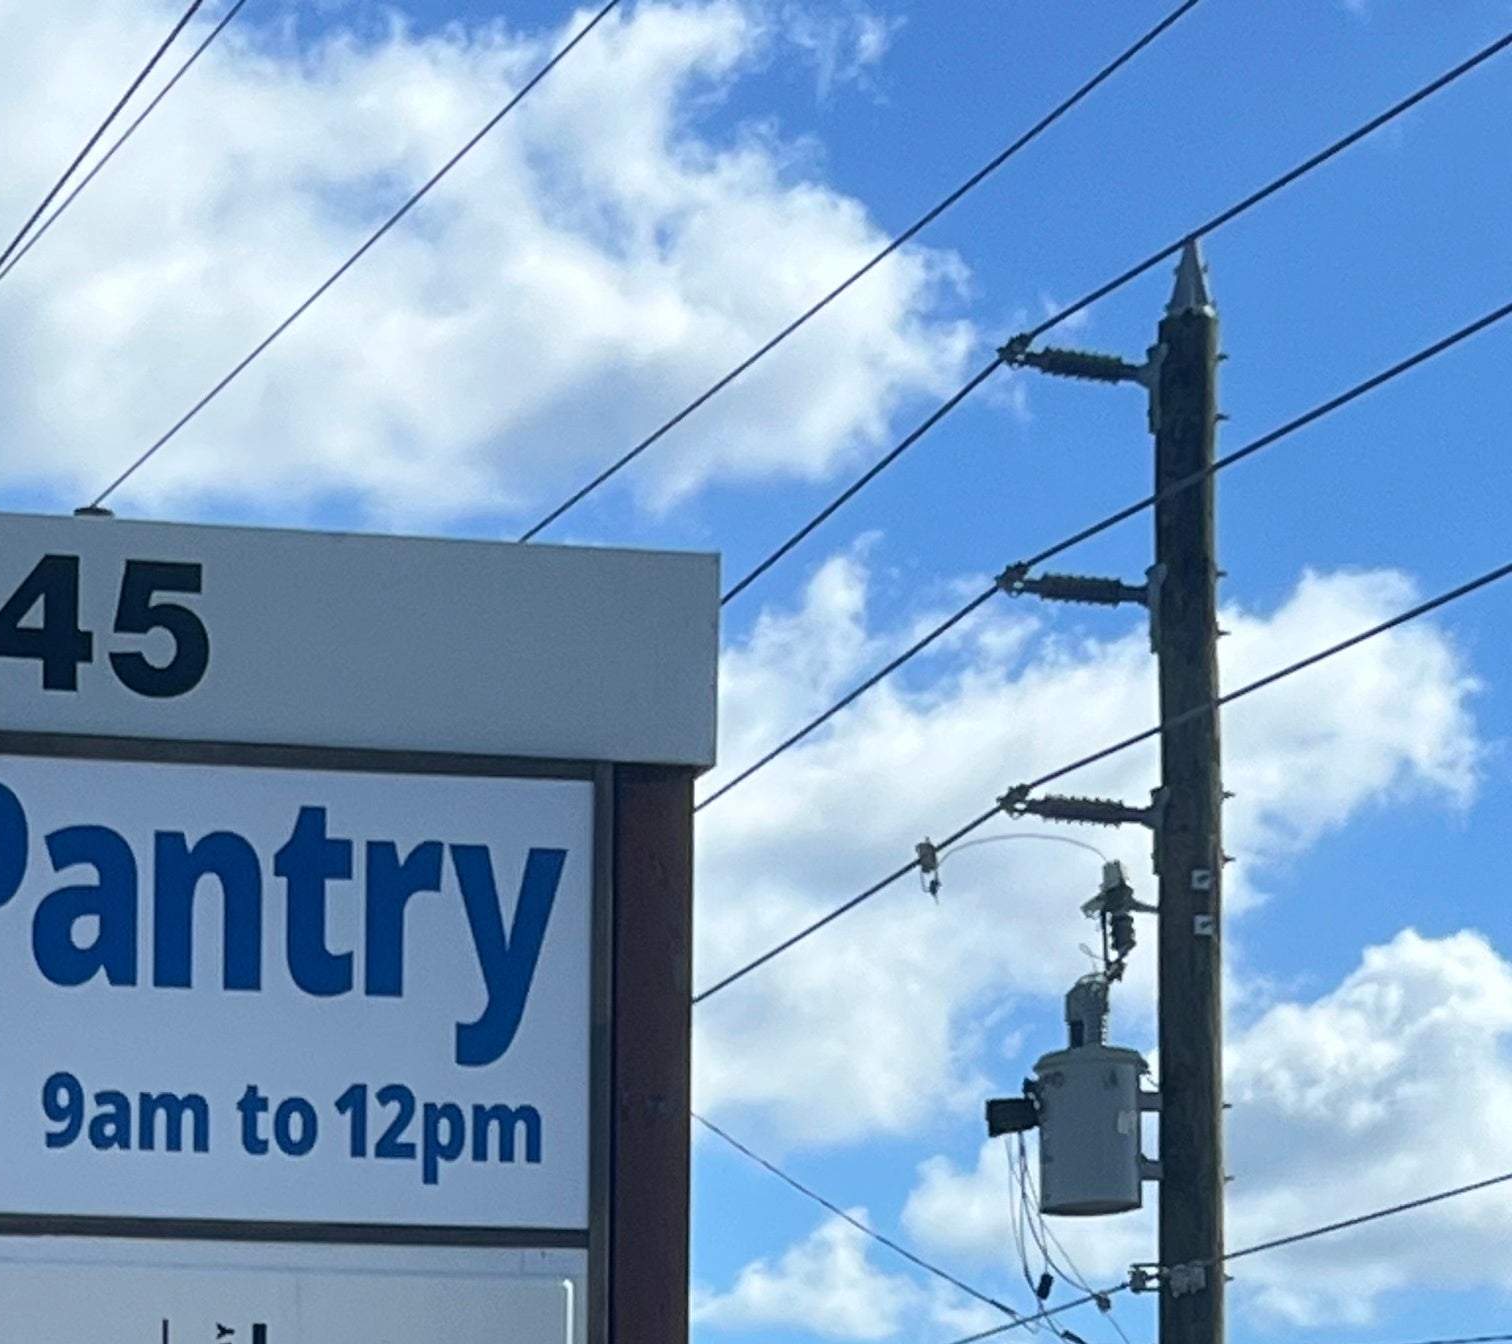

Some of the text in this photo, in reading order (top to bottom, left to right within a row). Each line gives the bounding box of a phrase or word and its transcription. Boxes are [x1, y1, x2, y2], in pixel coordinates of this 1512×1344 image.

[41, 1071, 210, 1154] 9am
[237, 1084, 318, 1158] to
[334, 1083, 542, 1186] 12pm
